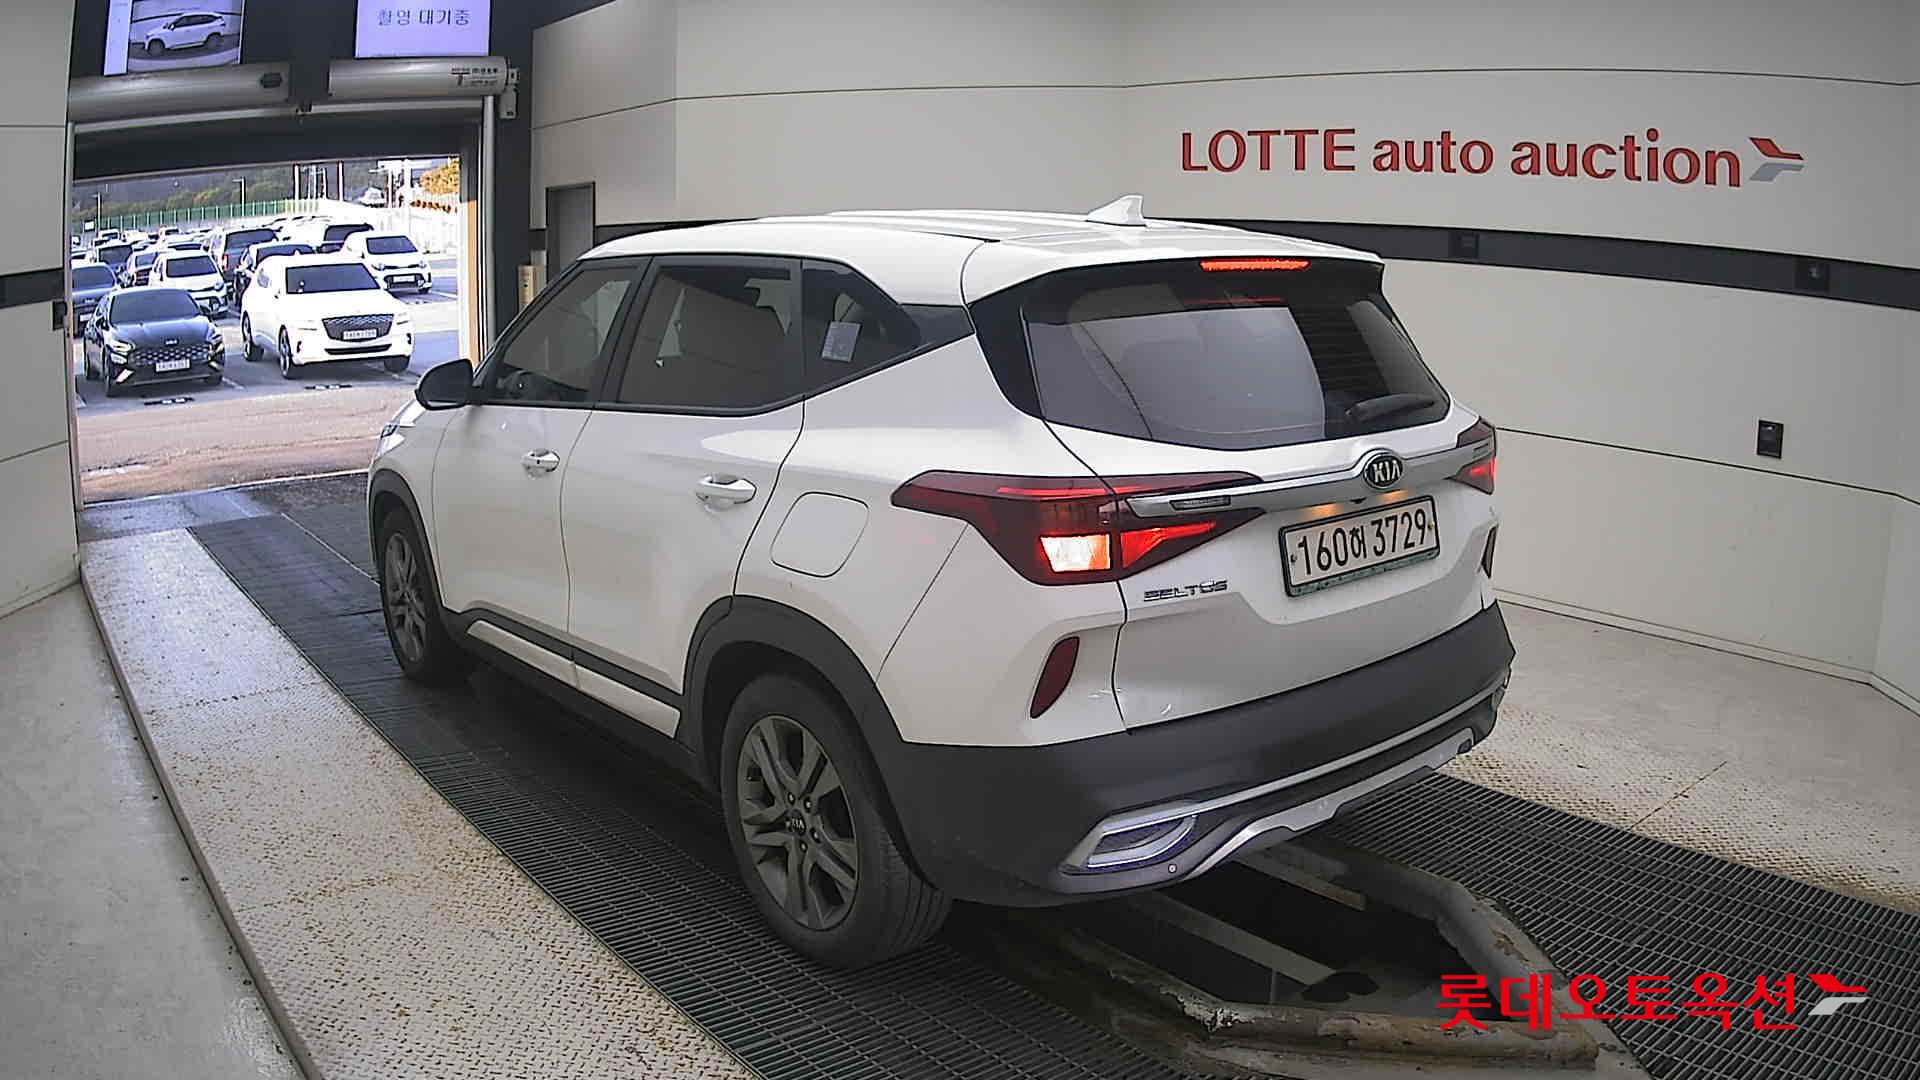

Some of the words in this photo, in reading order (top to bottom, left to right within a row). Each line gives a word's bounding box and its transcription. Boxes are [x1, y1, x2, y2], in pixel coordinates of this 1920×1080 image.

[418, 9, 469, 26] 대기중
[1182, 128, 1356, 172] LOTTE
[1373, 131, 1495, 174] auto
[1511, 128, 1741, 188] auction
[1372, 459, 1401, 483] KIA
[1143, 579, 1228, 602] SELTOS
